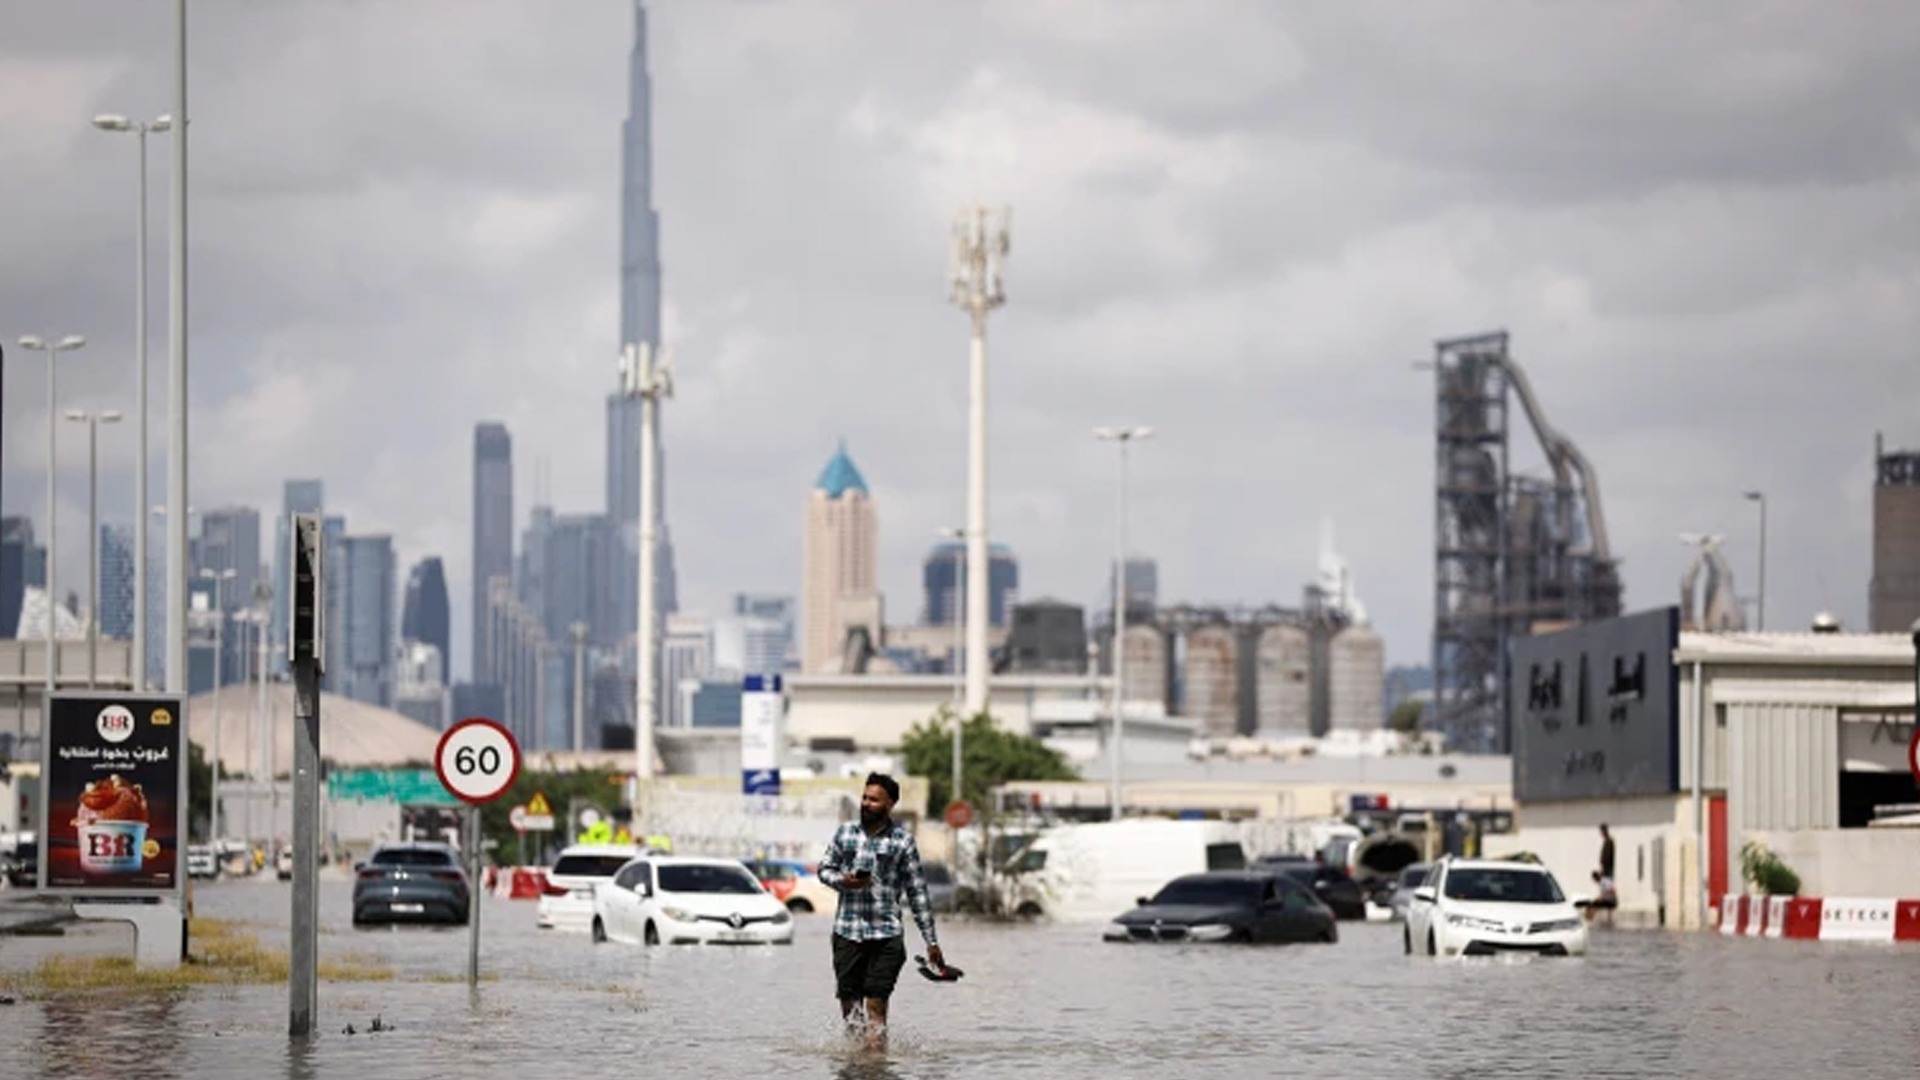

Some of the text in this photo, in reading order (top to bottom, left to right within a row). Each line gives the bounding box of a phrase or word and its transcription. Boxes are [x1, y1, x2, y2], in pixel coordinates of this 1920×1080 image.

[455, 745, 500, 776] 60
[88, 833, 135, 857] BR
[1824, 908, 1890, 920] SETECH
